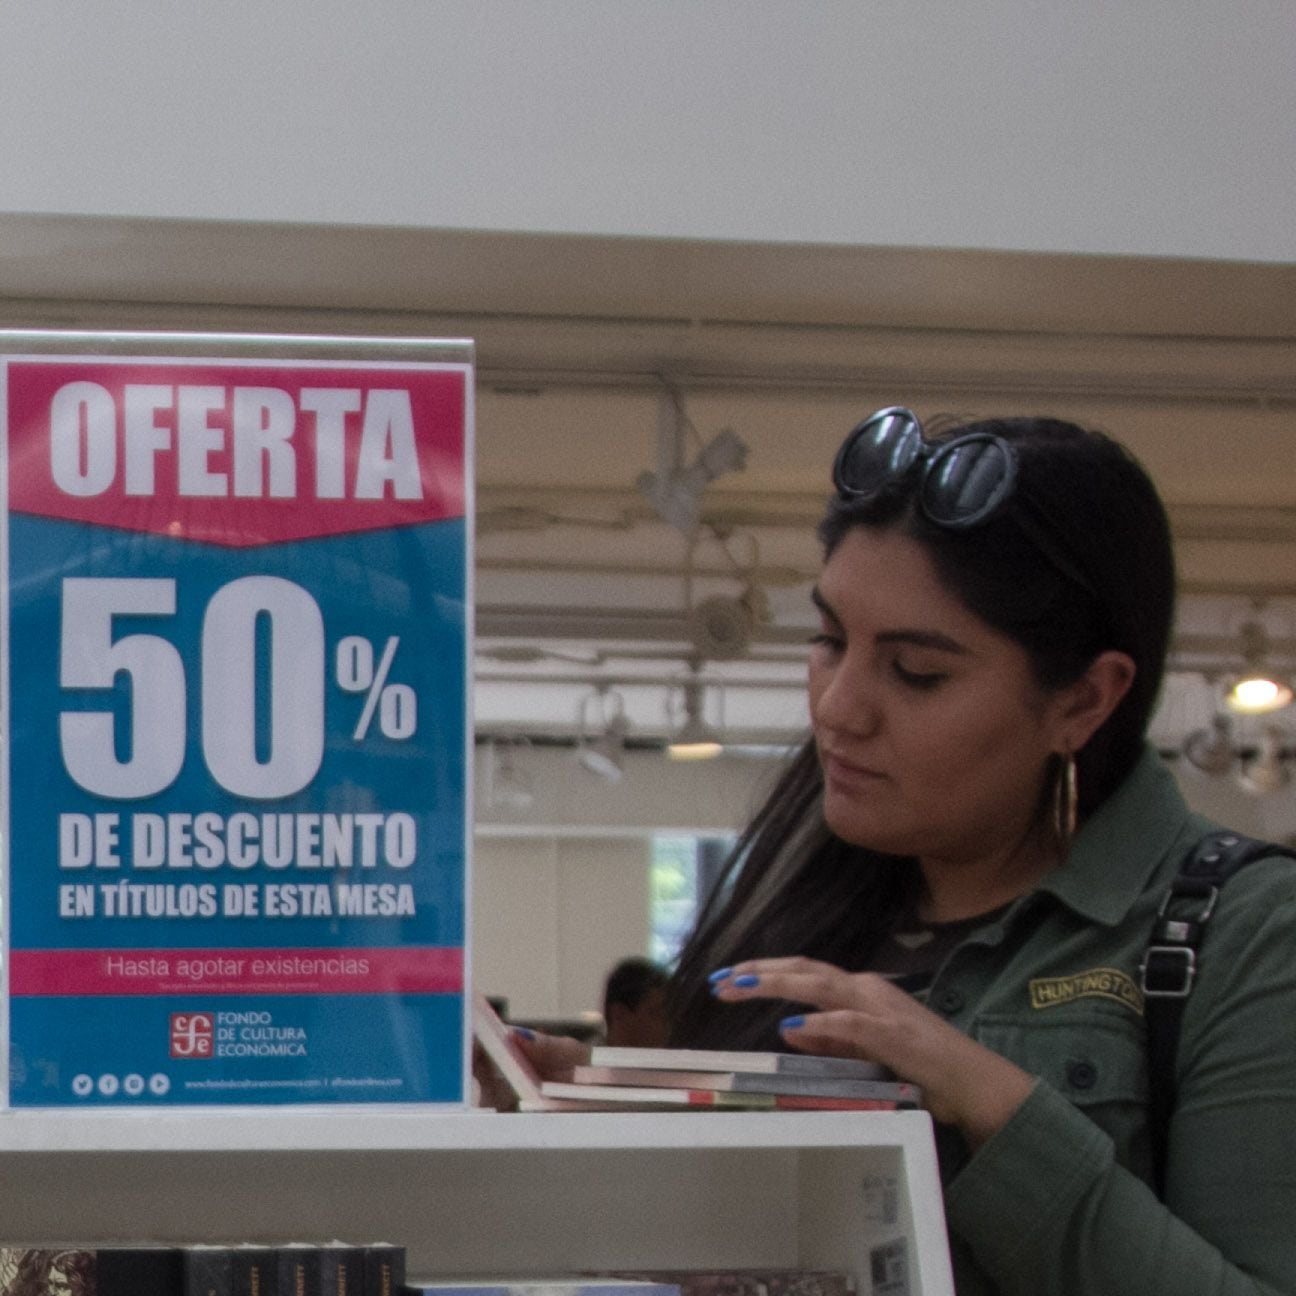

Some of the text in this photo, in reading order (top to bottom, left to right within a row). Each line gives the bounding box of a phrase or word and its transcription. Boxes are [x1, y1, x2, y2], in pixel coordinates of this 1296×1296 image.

[49, 380, 425, 501] OFERTA
[58, 812, 417, 868] DE DESCUENTO
[59, 879, 416, 917] EN TÍTULOS DE ESTA MESA
[106, 955, 370, 981] Hasta agotar existencias
[1037, 973, 1139, 1002] HUNTINGTO
[217, 1012, 272, 1025] FONDO
[217, 1027, 307, 1040] DE CULTURA
